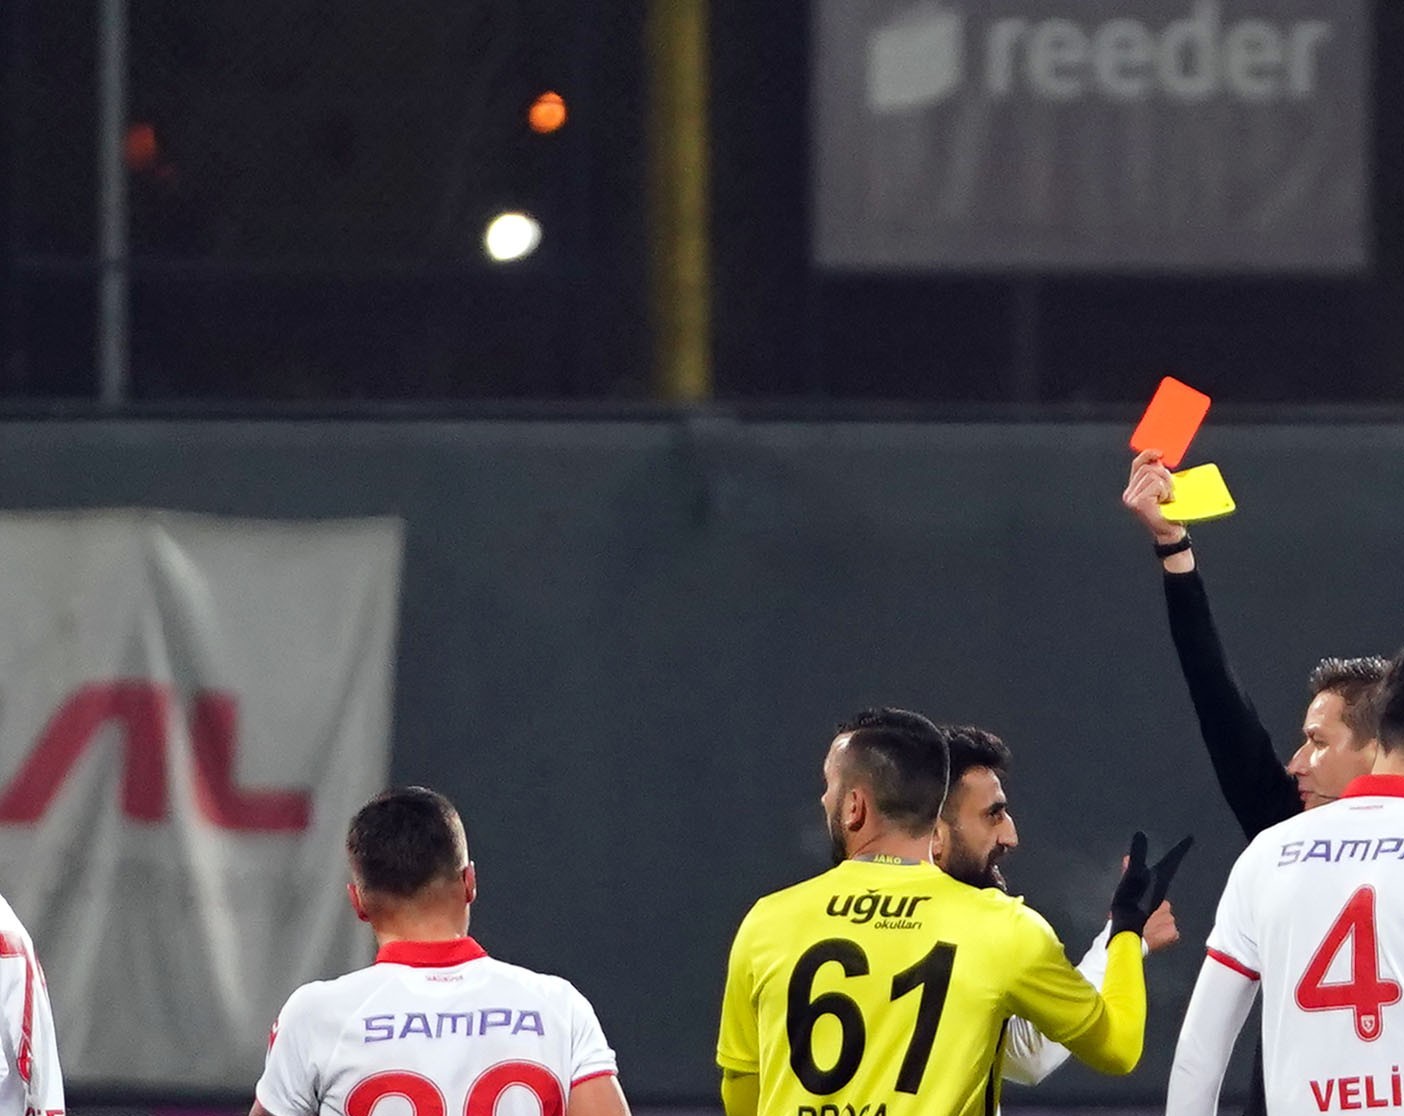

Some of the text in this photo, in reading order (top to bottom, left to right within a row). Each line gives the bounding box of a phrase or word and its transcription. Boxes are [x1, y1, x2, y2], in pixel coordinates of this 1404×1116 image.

[985, 0, 1331, 98] reeder
[826, 889, 932, 924] uğur
[873, 919, 923, 930] okulları
[1294, 884, 1402, 1042] 4
[363, 1007, 545, 1044] SAMPA
[786, 937, 958, 1096] 61
[1309, 1065, 1402, 1112] VELİ
